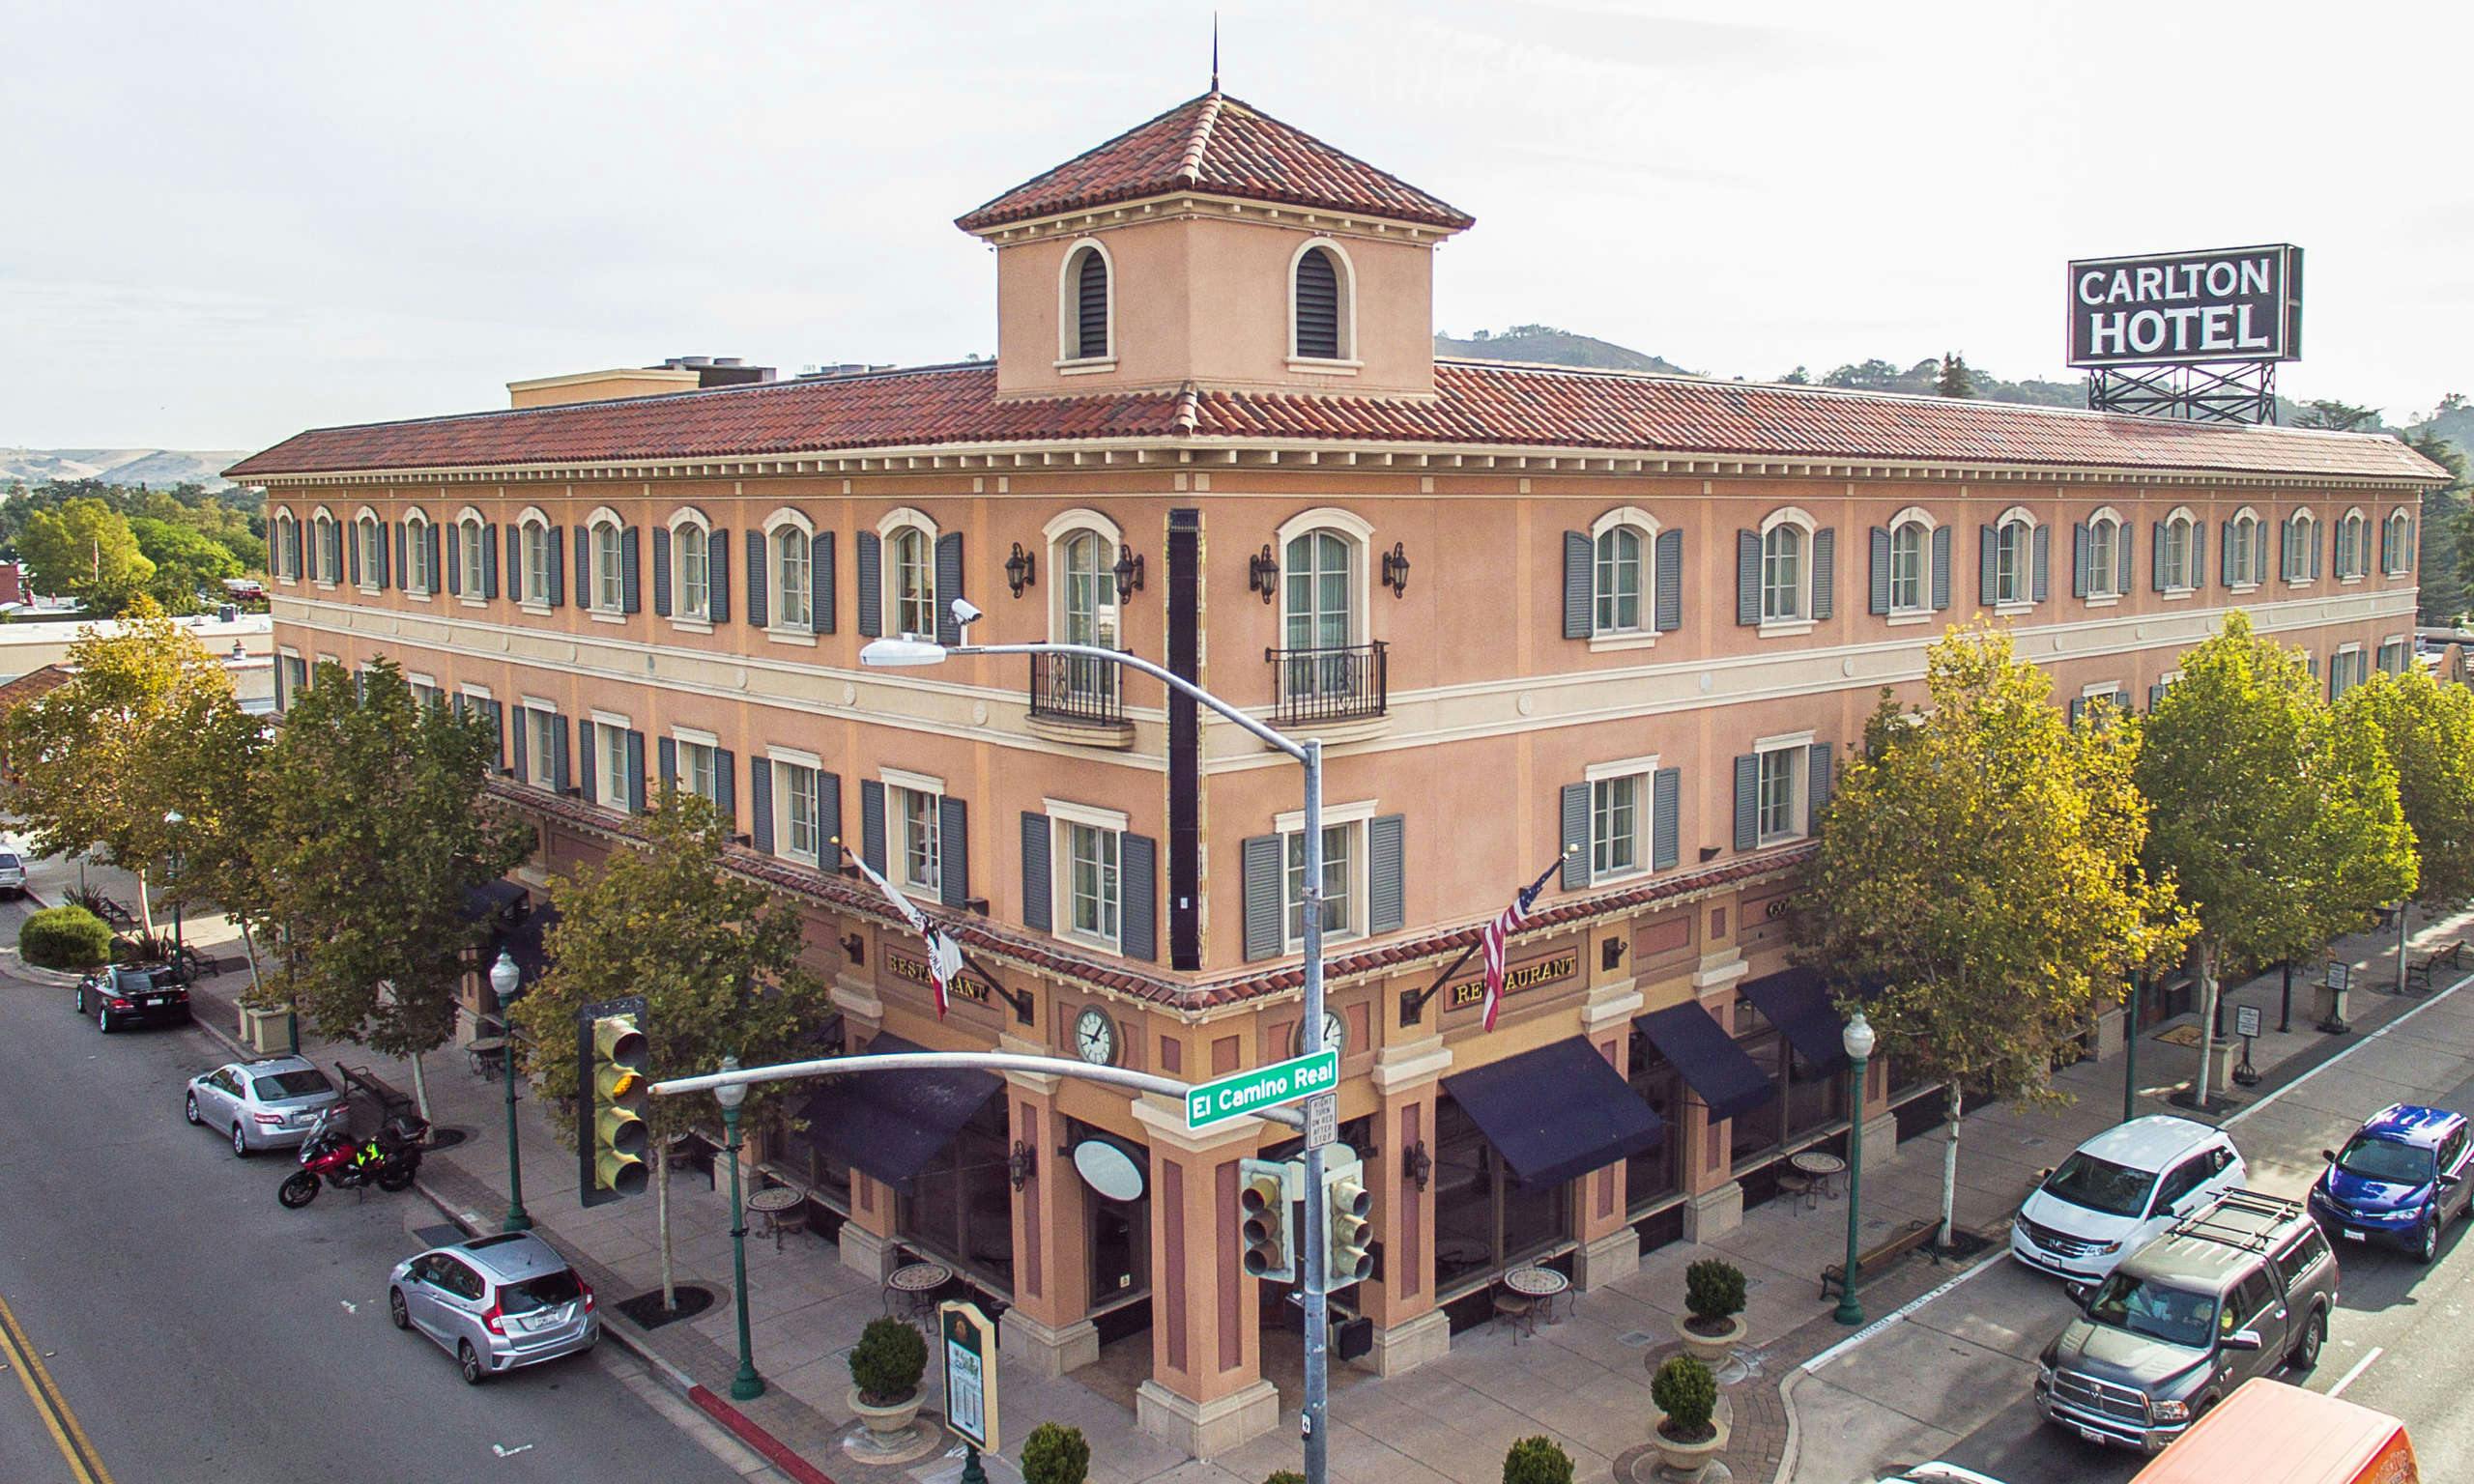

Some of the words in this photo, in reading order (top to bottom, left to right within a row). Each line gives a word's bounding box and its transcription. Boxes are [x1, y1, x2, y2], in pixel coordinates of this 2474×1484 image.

[2079, 258, 2270, 305] CARLTON
[2090, 303, 2269, 355] HOTEL
[888, 954, 988, 1002] RESTAANT
[1455, 956, 1576, 1005] REAURANT
[1193, 1095, 1211, 1119] El
[1219, 1077, 1287, 1110] Camino
[1295, 1060, 1333, 1089] Real
